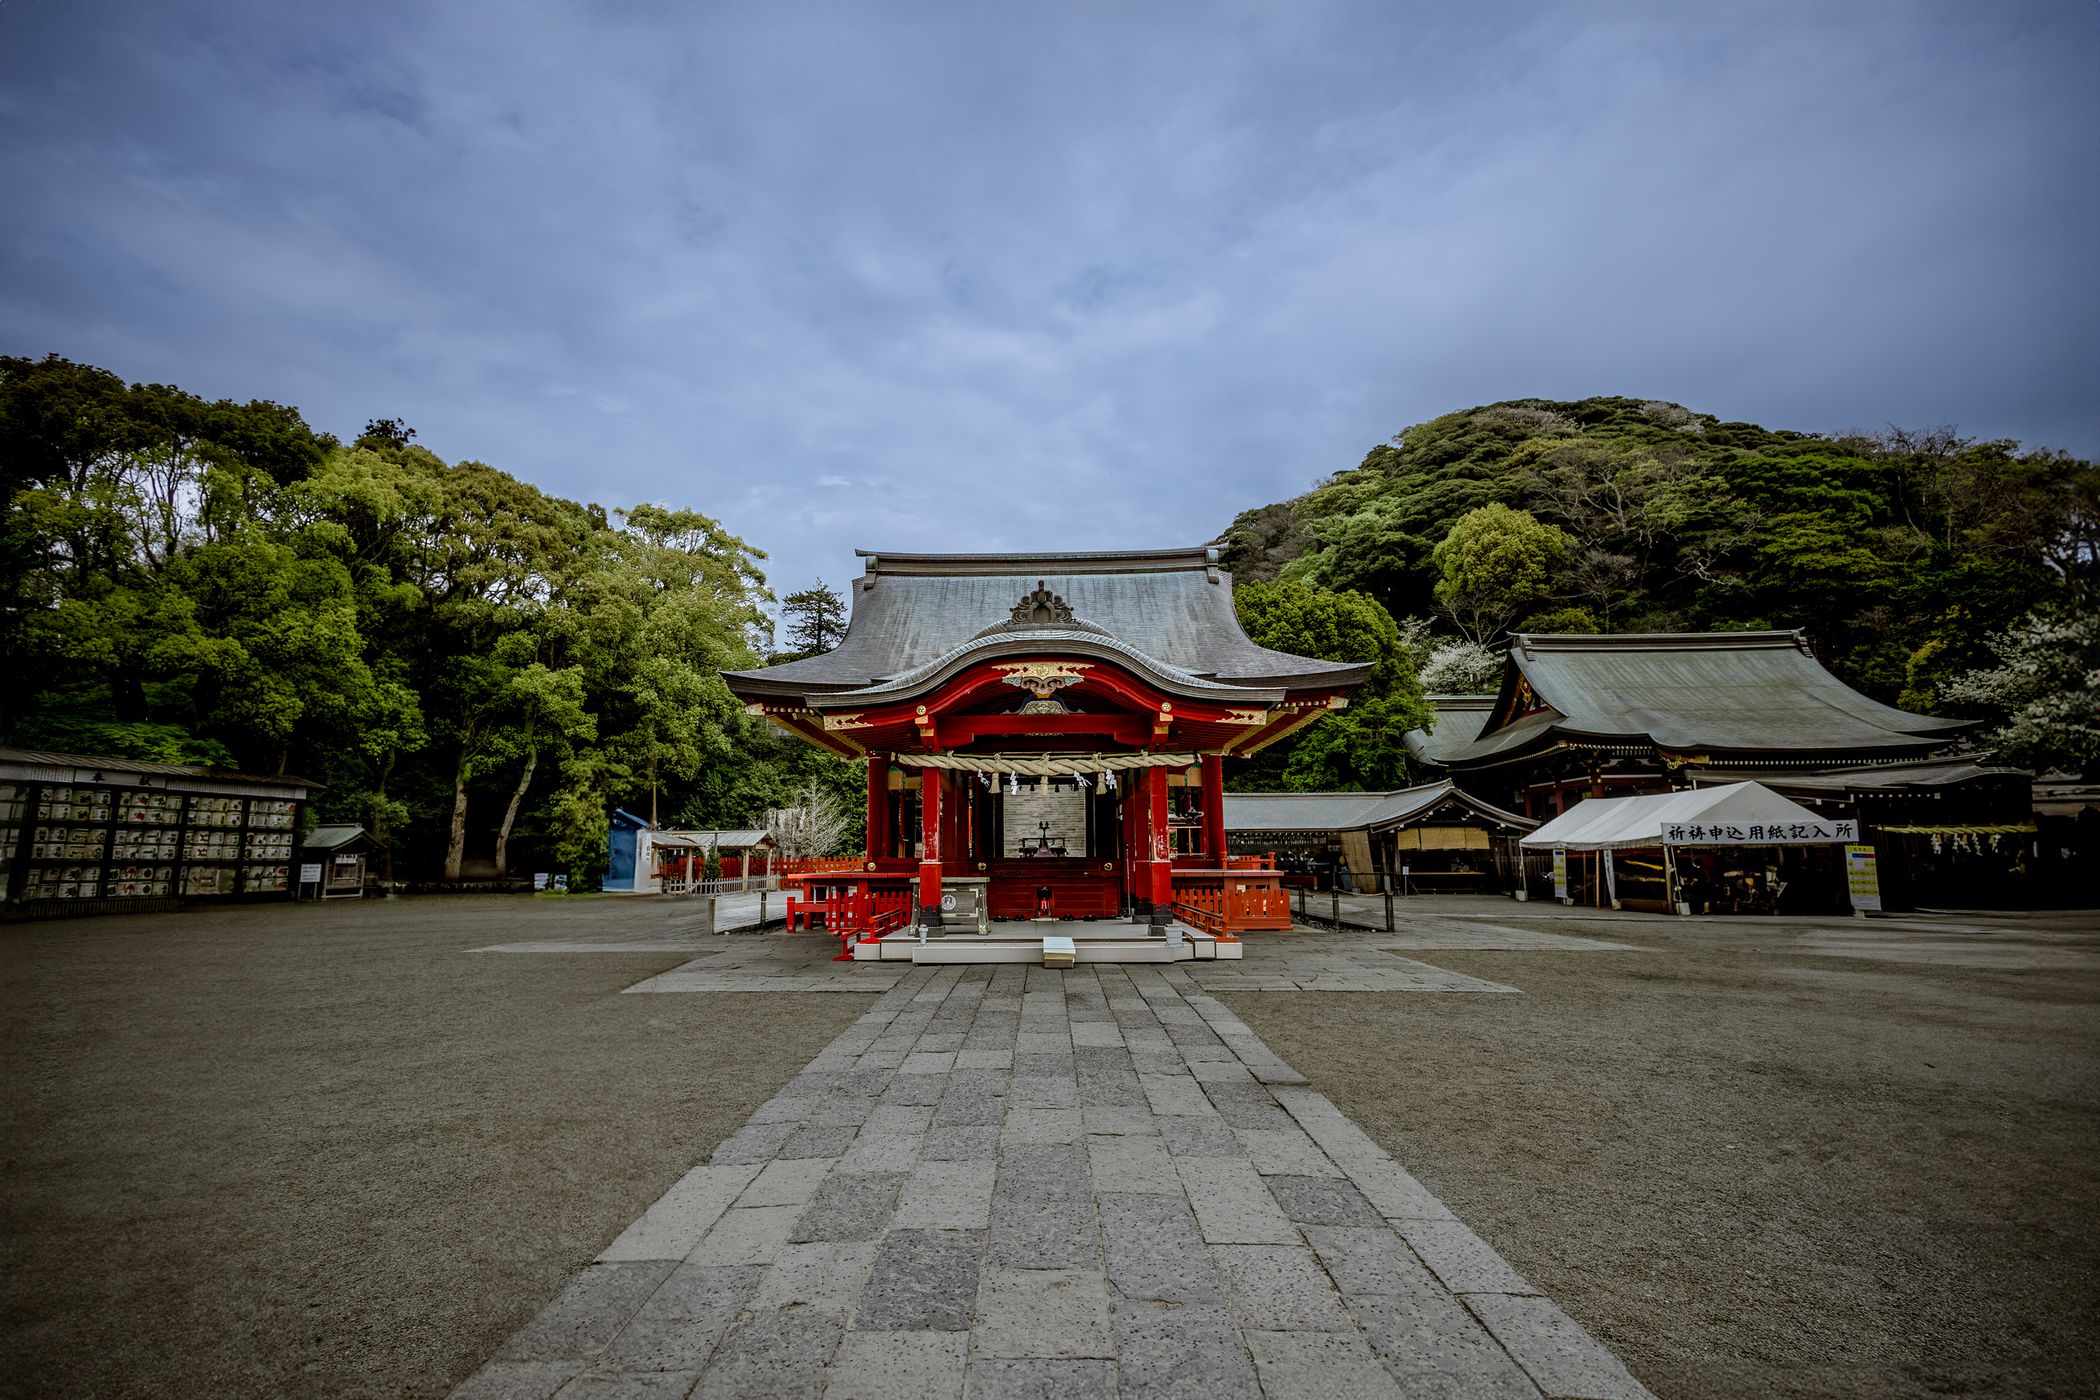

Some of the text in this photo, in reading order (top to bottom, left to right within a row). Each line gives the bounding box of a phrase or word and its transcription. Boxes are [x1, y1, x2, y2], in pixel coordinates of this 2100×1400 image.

[1668, 823, 1853, 840] 祈祷申込用紙記入所
